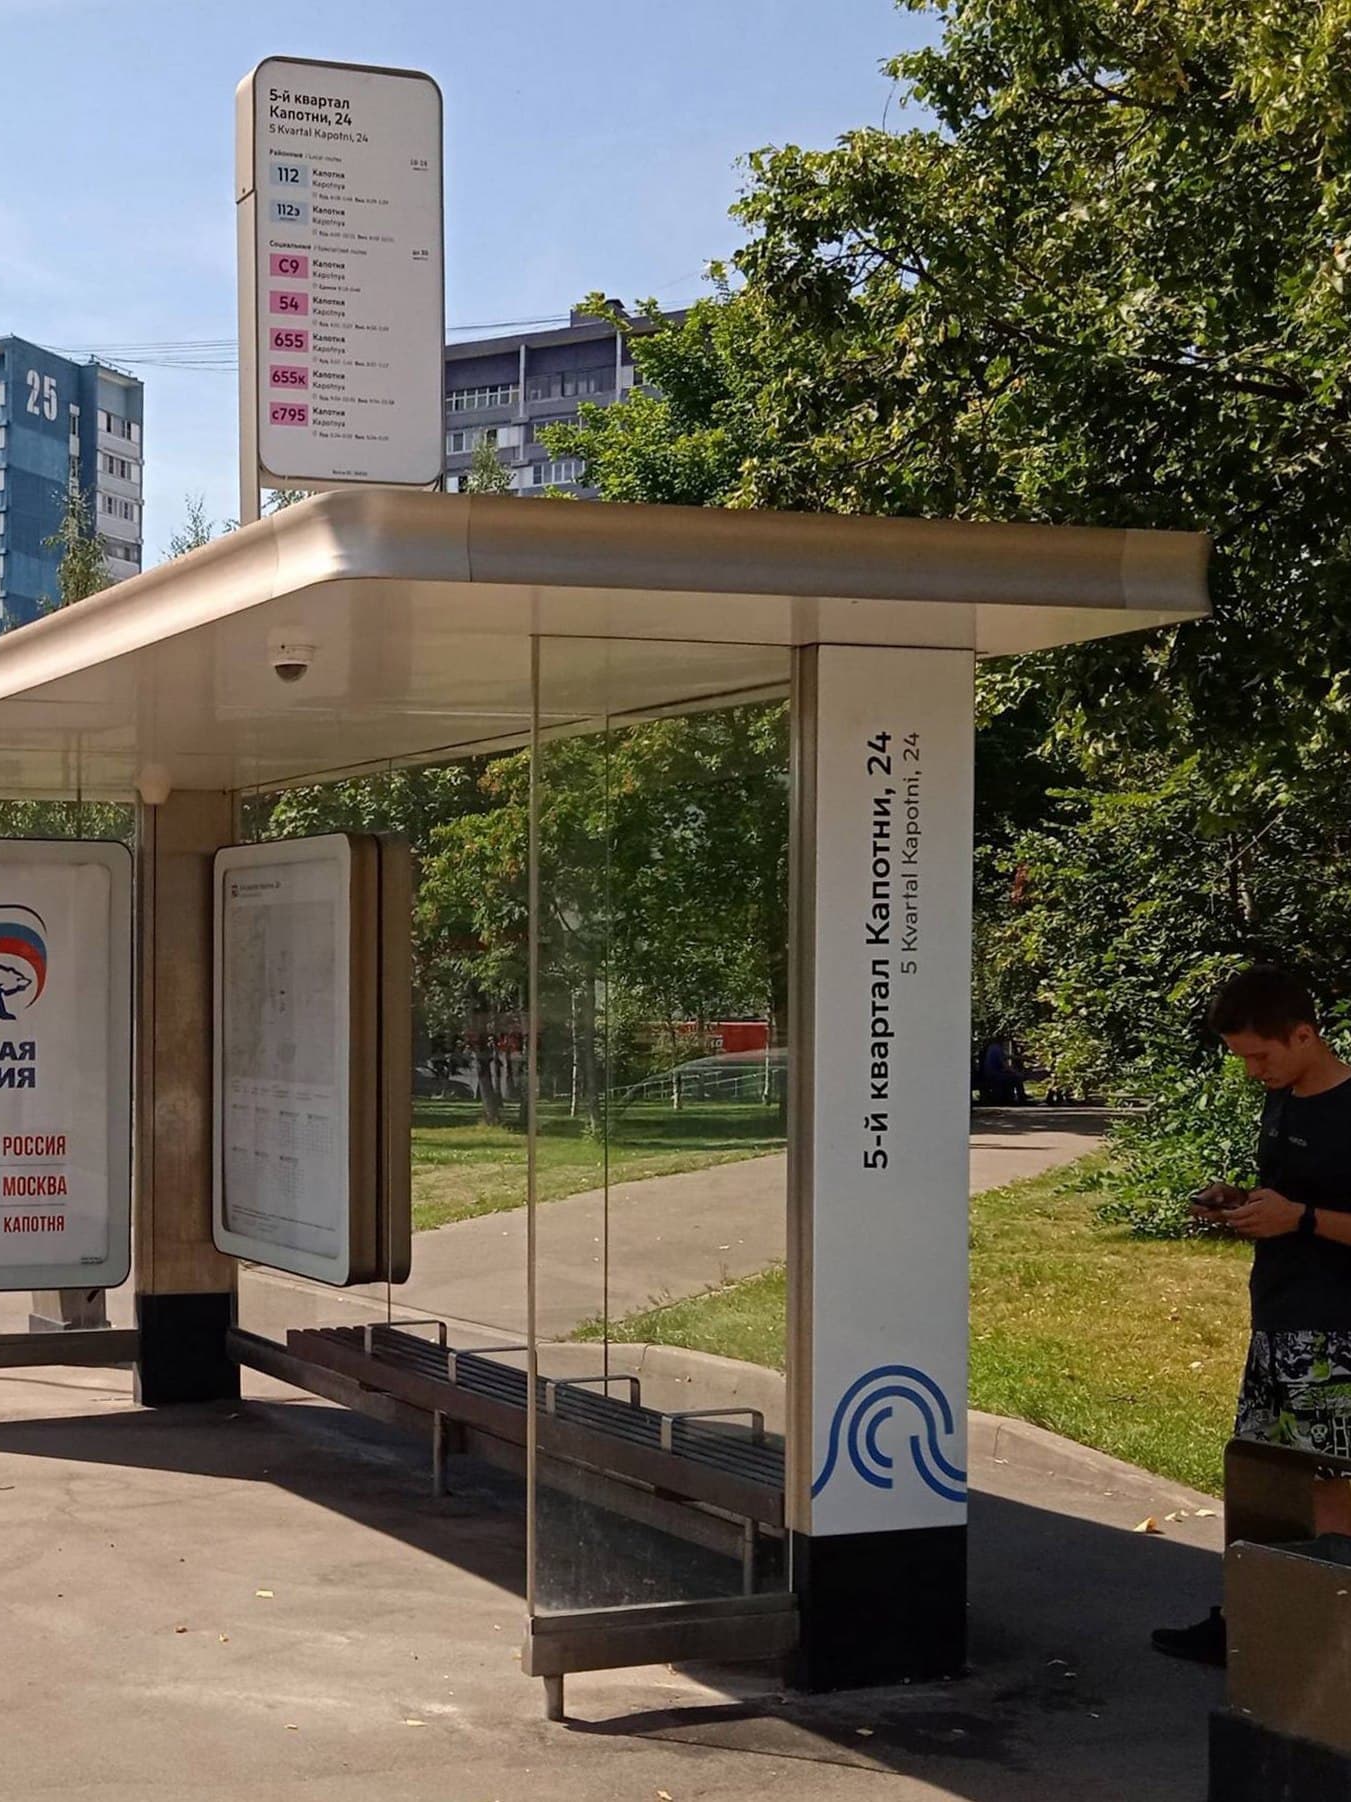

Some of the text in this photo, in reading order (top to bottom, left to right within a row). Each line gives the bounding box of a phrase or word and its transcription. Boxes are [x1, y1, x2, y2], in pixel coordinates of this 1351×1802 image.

[269, 88, 350, 110] 5-й квартал
[269, 105, 352, 126] Капотни, 24
[269, 124, 368, 143] 5 Kvartal Kapotni, 24
[278, 167, 299, 184] 112
[277, 204, 300, 217] 112э
[278, 258, 299, 275] С9
[279, 296, 299, 311] 54
[274, 333, 304, 349] 655
[272, 370, 306, 385] 655к
[26, 369, 57, 421] 25
[272, 408, 306, 422] с795
[901, 732, 922, 974] 5 Kvartal Kapotni, 24
[863, 731, 896, 1170] 5-й квартал Капотни, 24
[2, 1135, 65, 1156] РОССИЯ
[2, 1175, 67, 1197] МОСКВА
[3, 1215, 64, 1234] КАПОТНЯ
